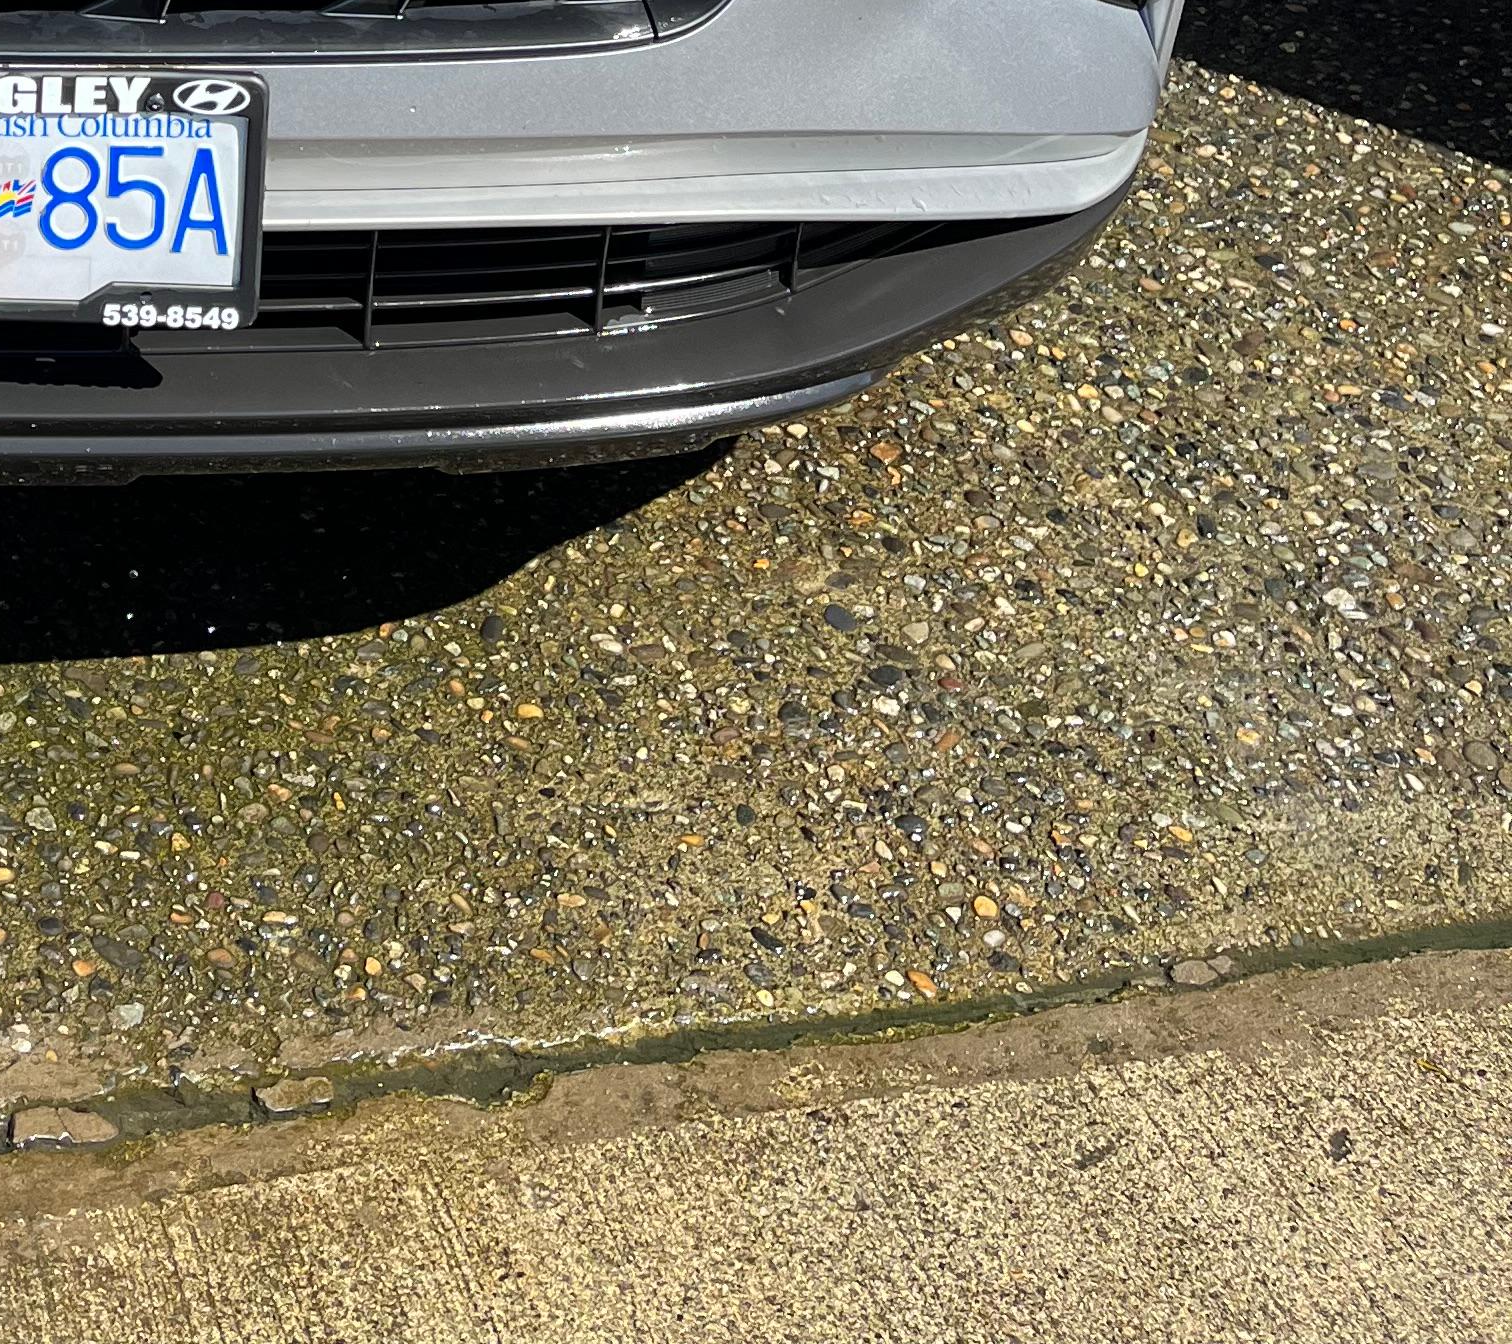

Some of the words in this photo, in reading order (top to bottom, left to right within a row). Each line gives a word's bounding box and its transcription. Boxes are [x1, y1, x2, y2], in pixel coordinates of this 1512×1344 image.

[58, 112, 213, 139] Columbia
[39, 146, 229, 256] 85A
[102, 303, 240, 330] 539-8549
